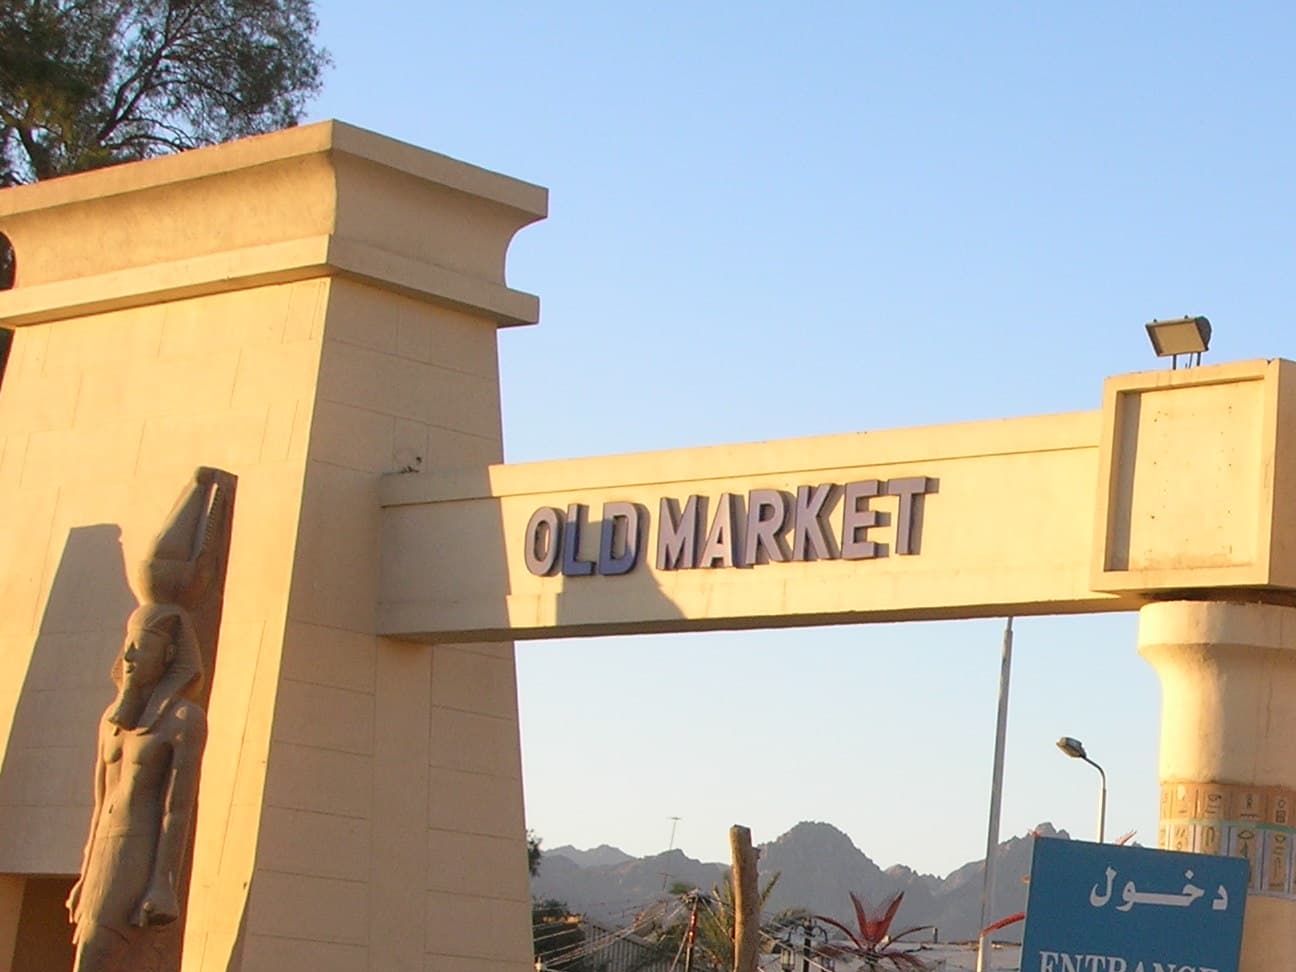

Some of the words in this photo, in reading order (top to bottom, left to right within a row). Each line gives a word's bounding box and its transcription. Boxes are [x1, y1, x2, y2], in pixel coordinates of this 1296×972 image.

[524, 501, 648, 577] OLD
[656, 476, 940, 570] MARKET
[1089, 866, 1229, 912] دخول
